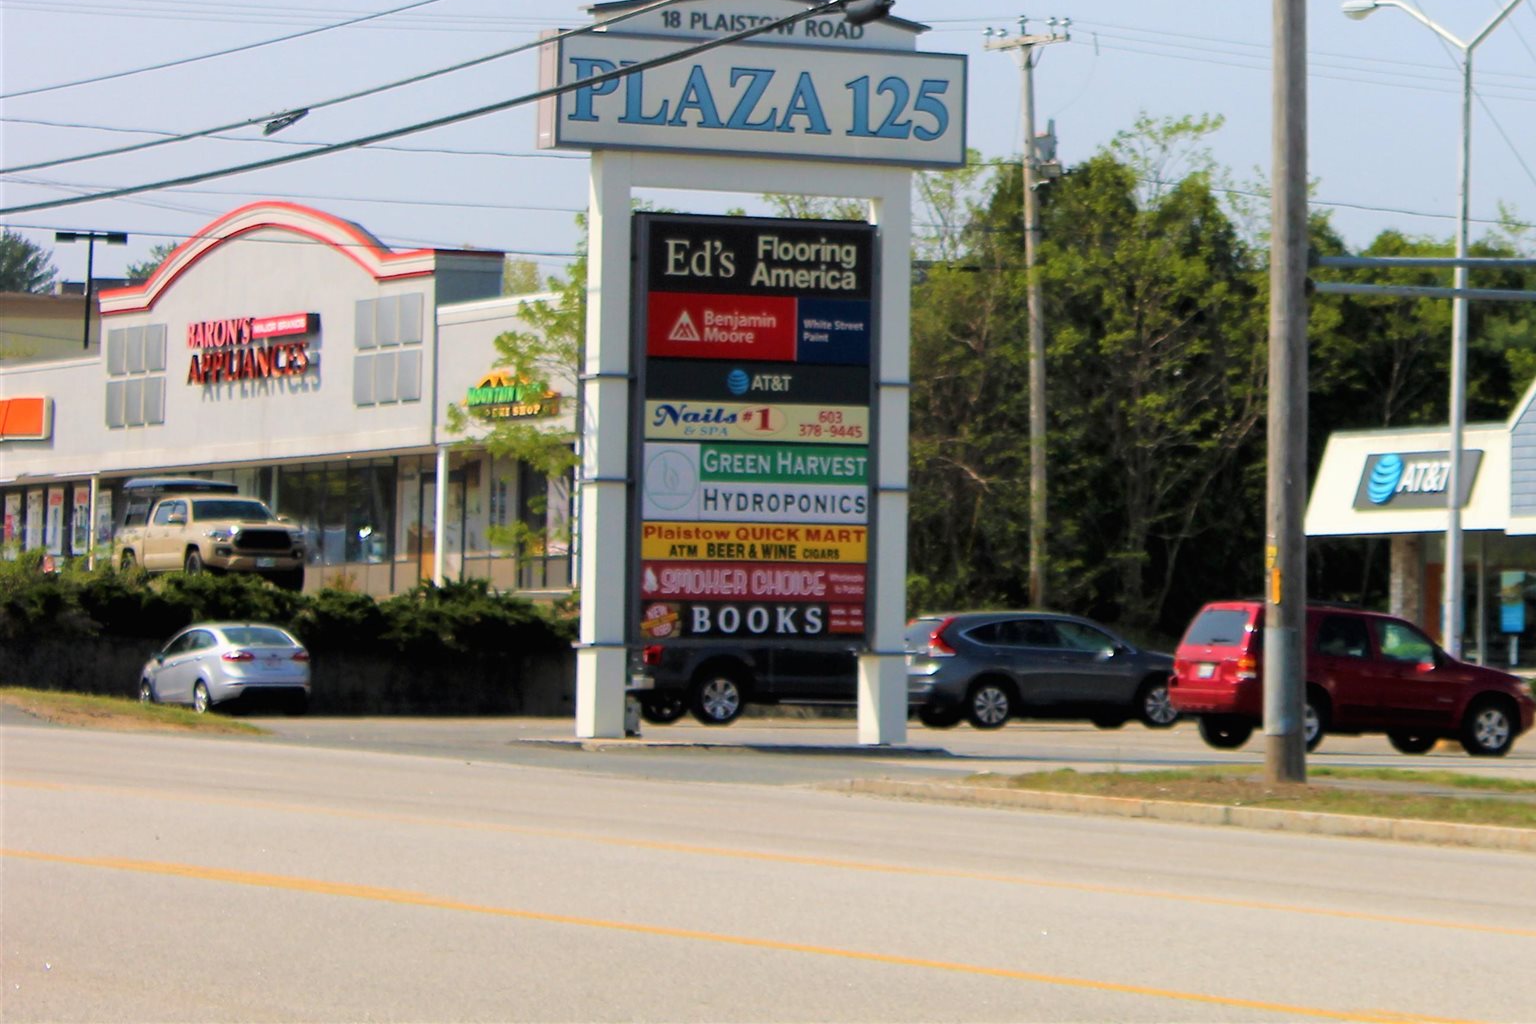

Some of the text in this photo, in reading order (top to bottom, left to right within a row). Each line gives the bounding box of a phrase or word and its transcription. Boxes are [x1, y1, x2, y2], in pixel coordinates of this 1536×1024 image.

[662, 10, 681, 29] 18
[805, 19, 863, 40] ROAD
[568, 58, 950, 141] PLAZA 125
[664, 239, 736, 278] Ed's
[758, 236, 856, 269] Flooring
[751, 263, 856, 290] America
[704, 311, 776, 330] Benjamin
[803, 319, 832, 330] White
[188, 318, 251, 348] BARON'S
[704, 328, 754, 343] Moore
[803, 332, 829, 342] Paint
[188, 341, 308, 385] APPLIANCES
[752, 375, 792, 391] AT&T
[653, 404, 738, 426] Nails
[819, 411, 842, 424] 603
[700, 427, 727, 436] SPA
[799, 425, 862, 438] 378-9445
[703, 450, 866, 476] GREEN HARVEST
[703, 489, 866, 514] HYDROPONICS
[644, 526, 866, 543] Plaistow QUICK MART
[669, 544, 839, 560] ATM BEER & WINE CIGARS
[752, 570, 826, 595] CHOICE
[692, 606, 823, 634] BOOKS
